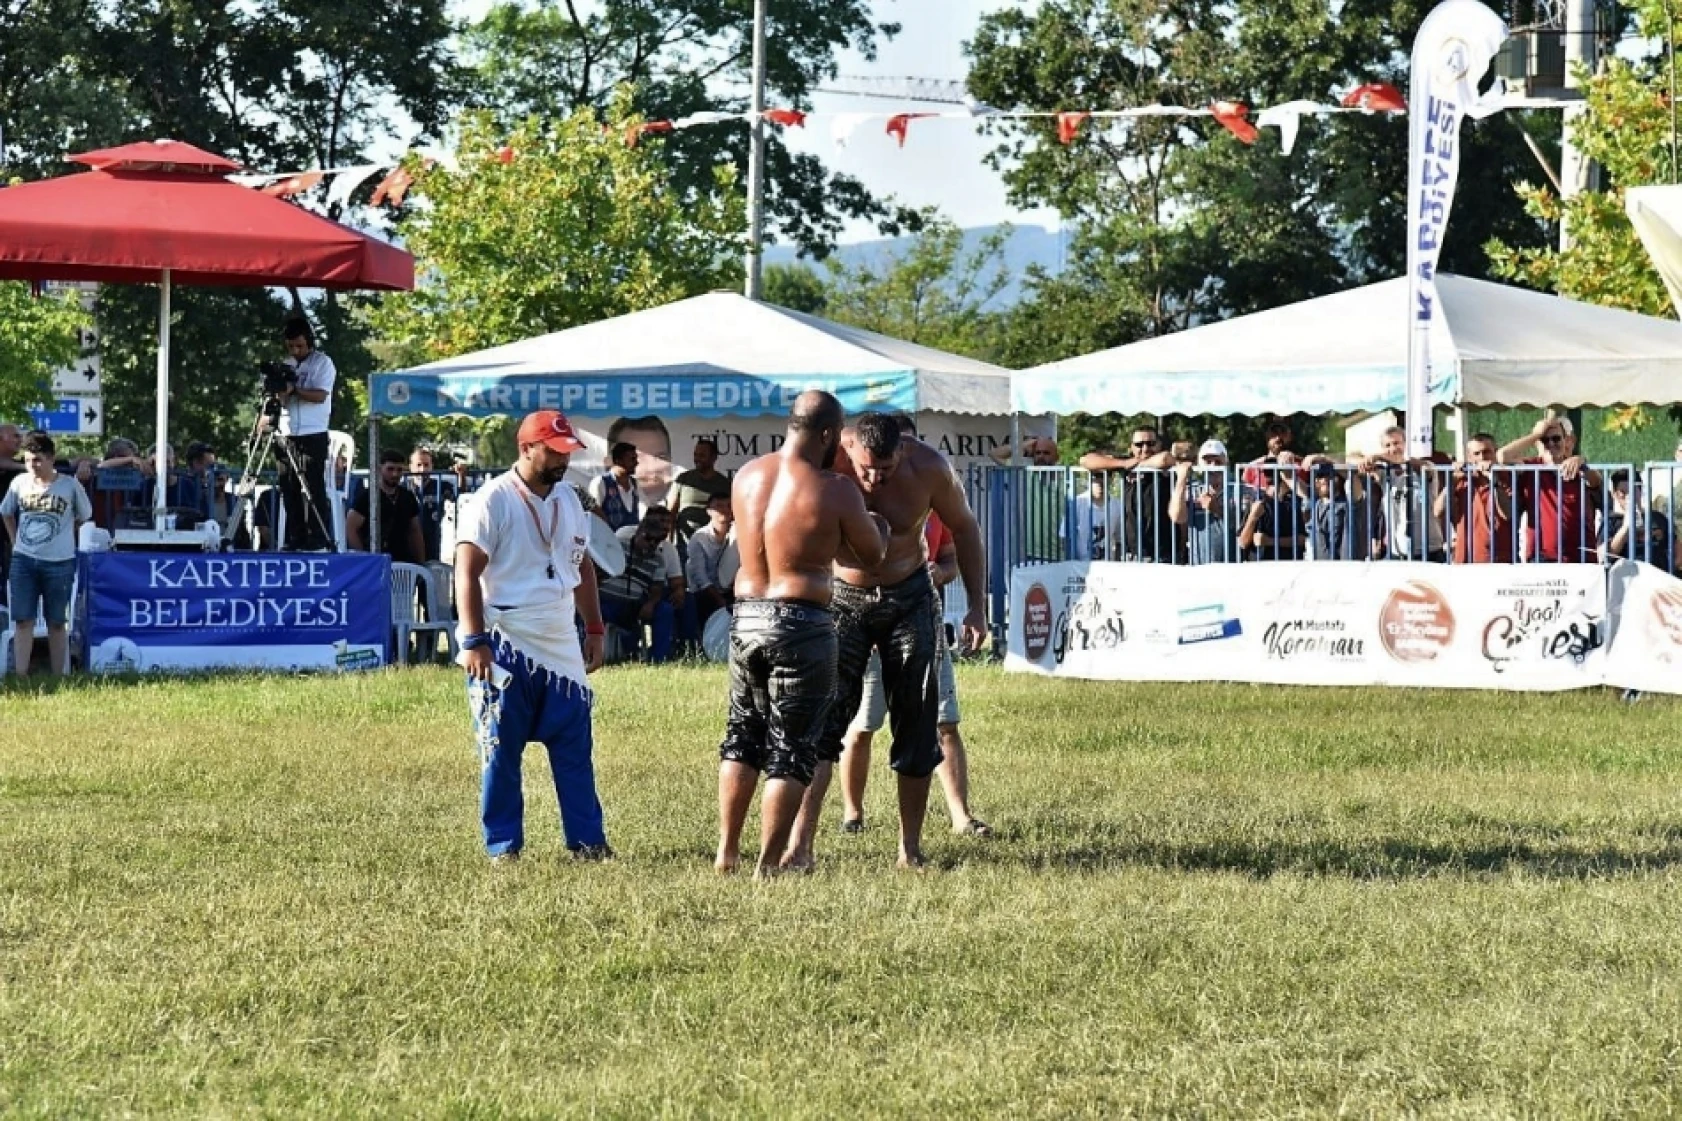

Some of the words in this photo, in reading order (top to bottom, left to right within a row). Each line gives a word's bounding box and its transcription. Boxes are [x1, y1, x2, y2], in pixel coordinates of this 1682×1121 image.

[436, 382, 608, 410] KARTEPE
[149, 559, 330, 588] KARTEPE
[129, 590, 349, 627] BELEDİYESİ
